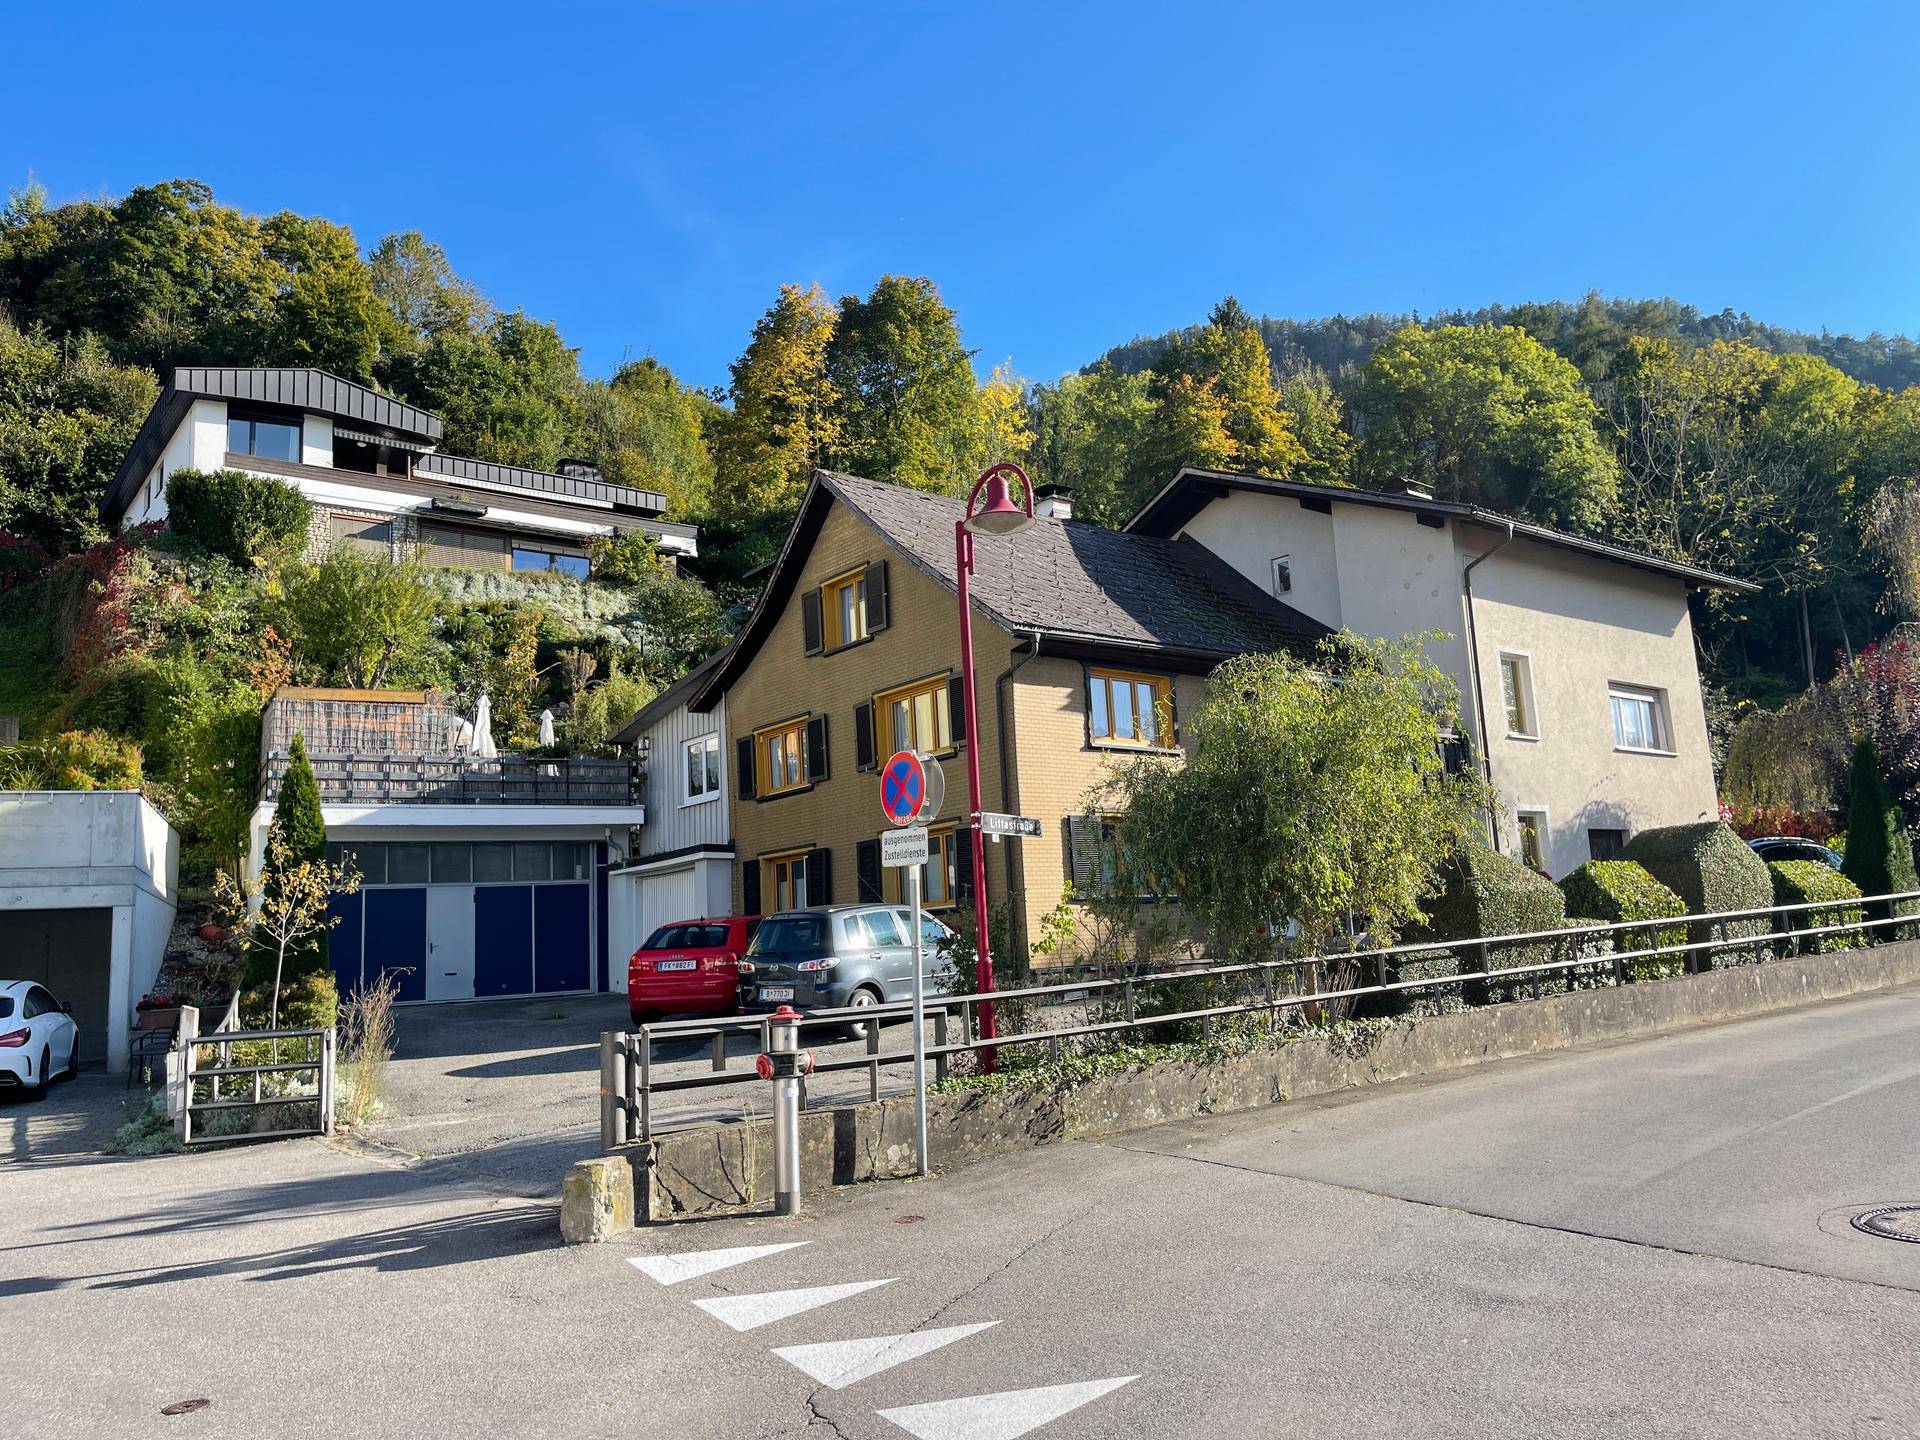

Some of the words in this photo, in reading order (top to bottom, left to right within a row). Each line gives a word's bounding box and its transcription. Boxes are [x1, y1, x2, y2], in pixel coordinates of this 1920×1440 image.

[990, 817, 1034, 831] Littastraße
[884, 833, 926, 846] ausgenommen
[884, 848, 926, 860] Zustelldienste
